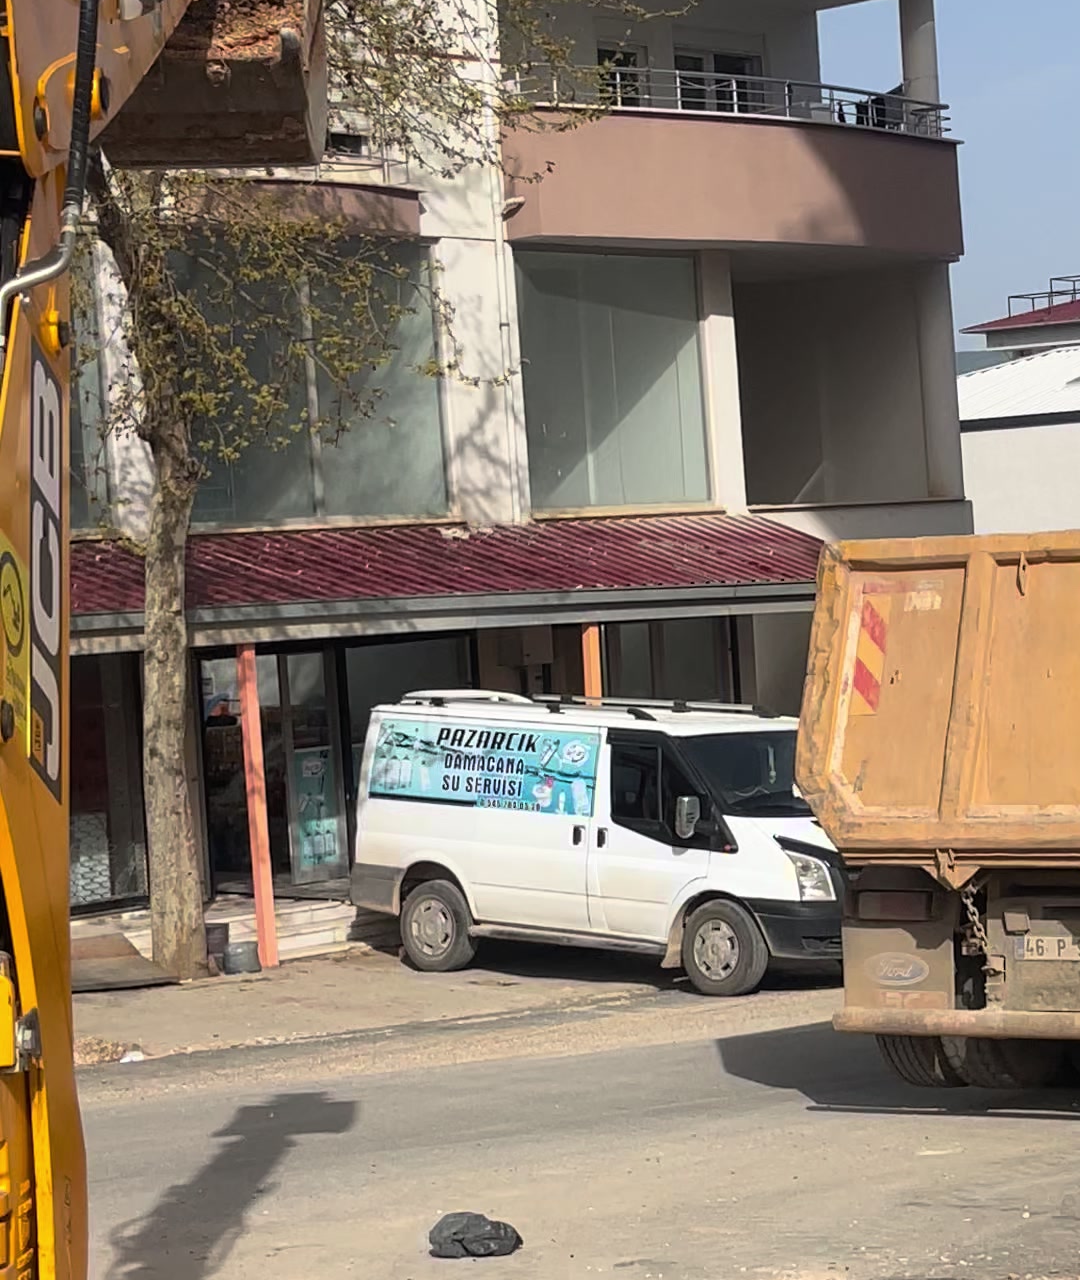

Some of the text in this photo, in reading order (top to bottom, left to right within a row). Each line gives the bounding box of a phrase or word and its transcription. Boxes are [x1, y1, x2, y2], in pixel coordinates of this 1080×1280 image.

[32, 359, 62, 783] JCB
[436, 727, 540, 753] PAZARCIK
[444, 753, 524, 775] DAMACANA
[442, 774, 460, 792] SU
[1026, 938, 1045, 957] 46
[1057, 938, 1067, 958] P
